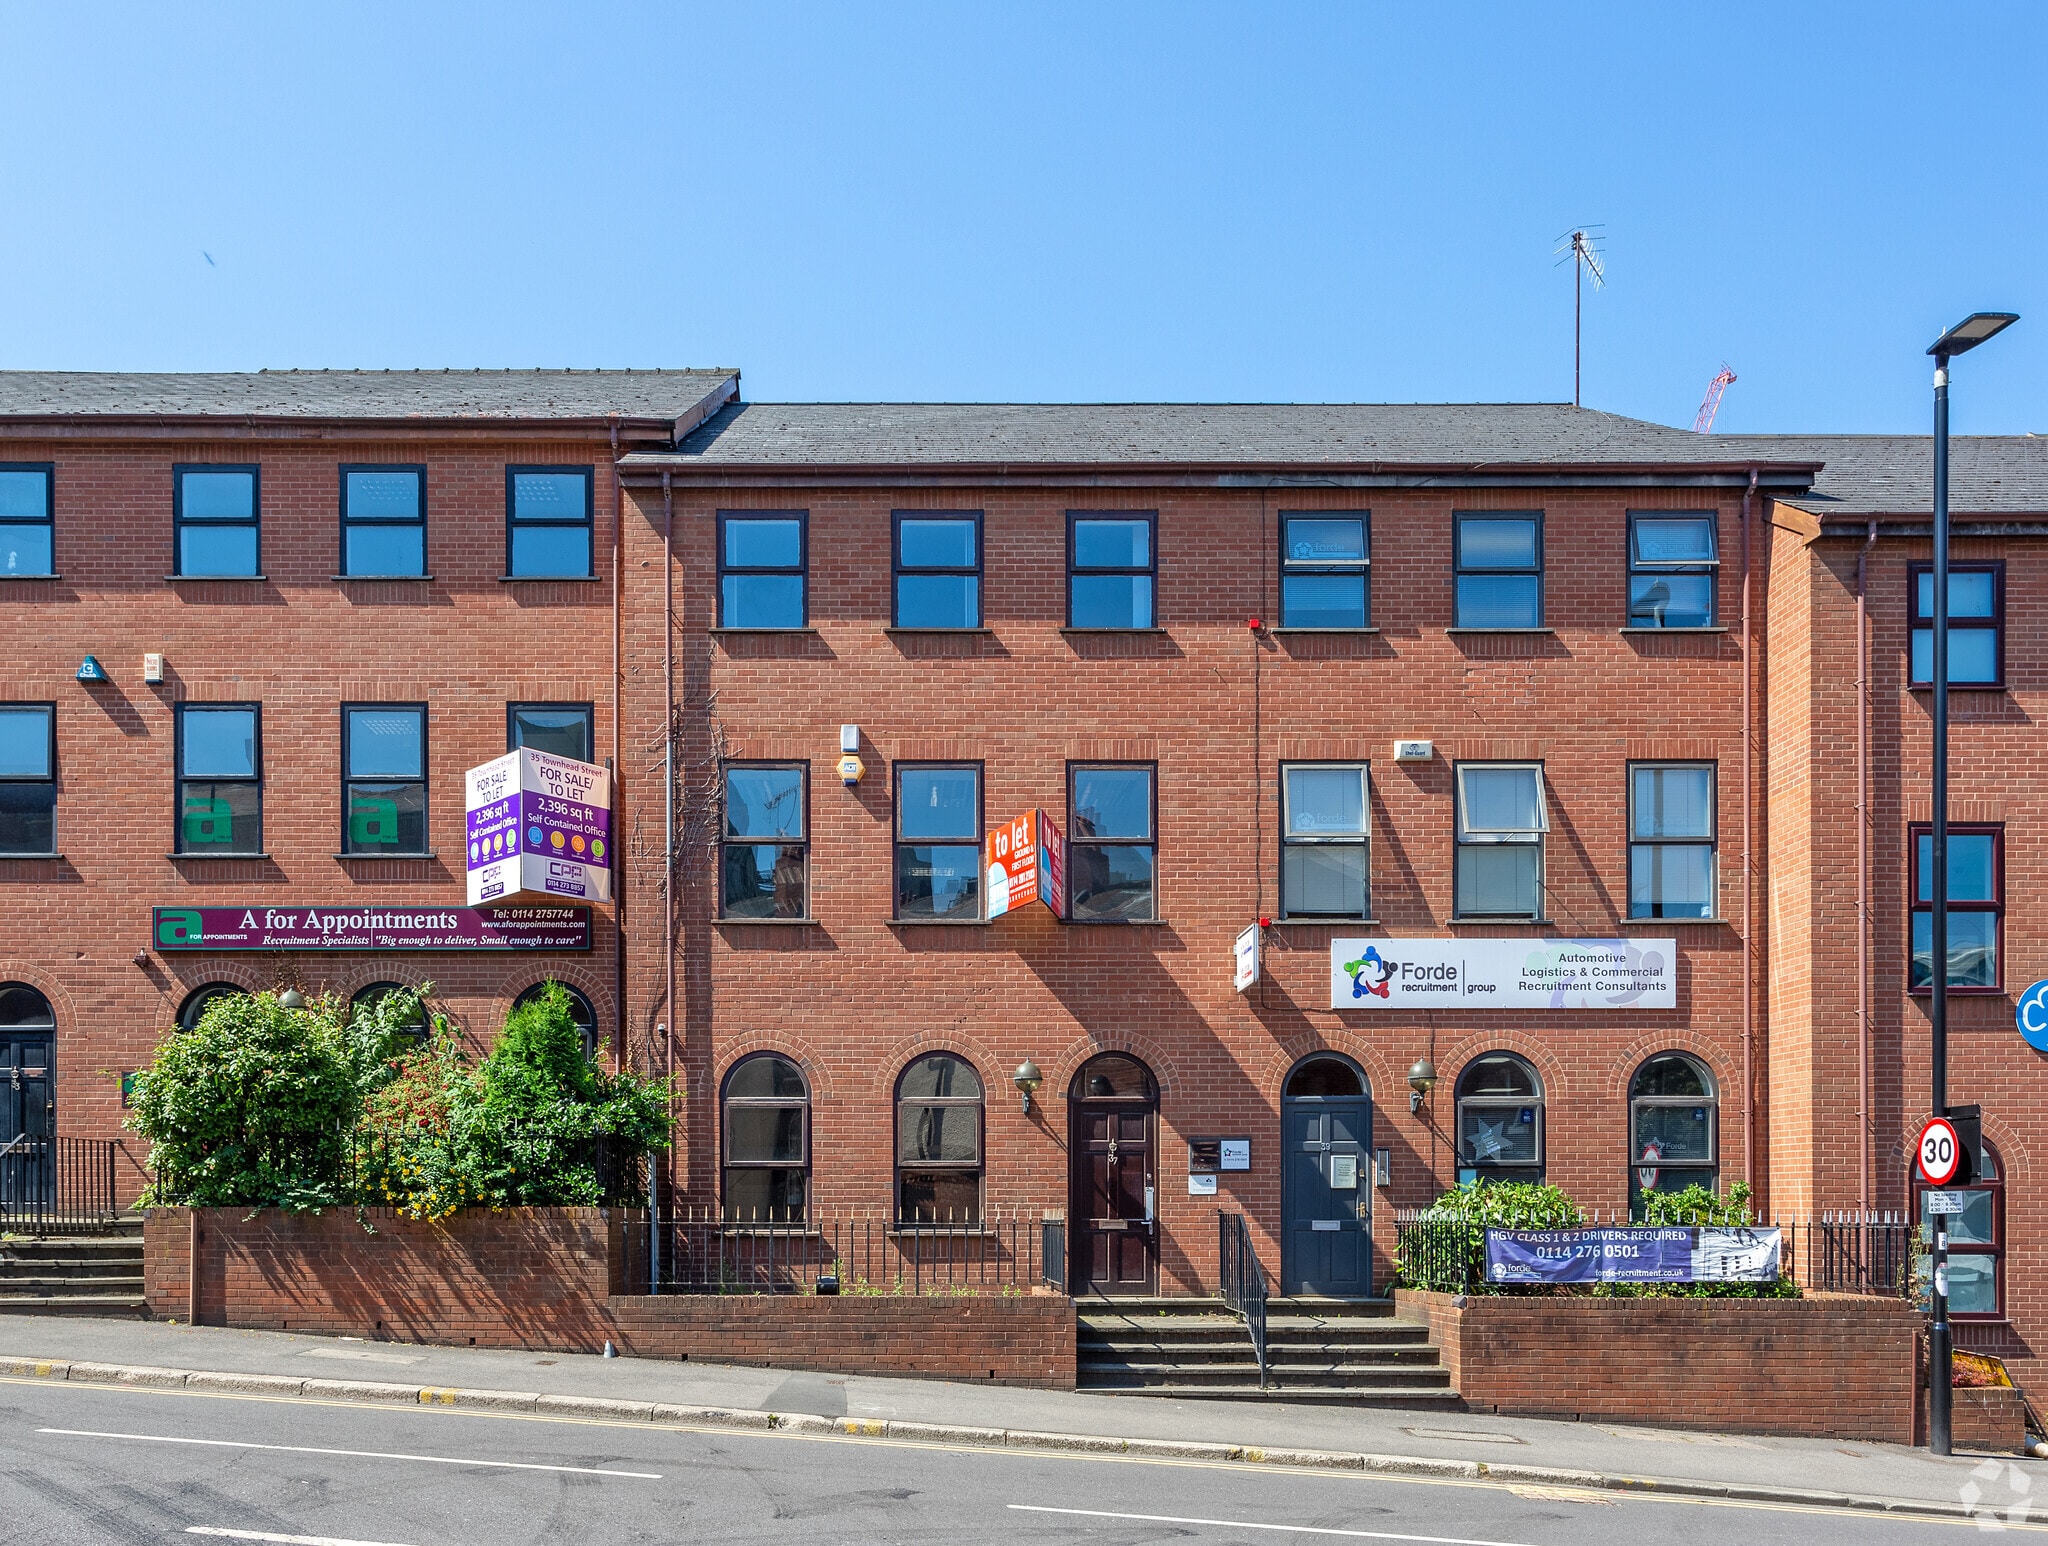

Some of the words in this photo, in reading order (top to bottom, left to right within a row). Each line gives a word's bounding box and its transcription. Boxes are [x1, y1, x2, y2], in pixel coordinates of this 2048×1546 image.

[530, 752, 540, 762] 35
[542, 756, 579, 772] Townhead
[581, 764, 603, 778] Street
[477, 778, 490, 792] FOR
[540, 766, 561, 782] FOR
[565, 772, 594, 790] SALE/
[482, 791, 491, 804] TO
[493, 786, 503, 799] LET
[549, 783, 563, 796] TO
[566, 787, 585, 801] LET
[476, 806, 494, 825] 2,396
[495, 805, 502, 818] sq
[503, 800, 509, 814] ft
[538, 798, 568, 815] 2,396
[570, 807, 582, 821] sq
[584, 808, 593, 821] ft
[470, 827, 480, 840] Self
[480, 820, 502, 837] Contained
[503, 816, 517, 828] Office
[528, 812, 542, 824] Self
[544, 816, 583, 833] Contained
[584, 824, 606, 838] Office
[995, 831, 1008, 858] to
[1012, 817, 1028, 850] let
[1044, 817, 1051, 849] to
[1052, 826, 1060, 859] let
[1012, 860, 1021, 871] FIRST
[1022, 854, 1035, 866] FLOOR
[239, 910, 259, 929] A
[265, 909, 297, 929] for
[303, 909, 457, 934] Appointments
[493, 909, 509, 918] Tel:
[512, 909, 533, 918] 0114
[536, 909, 574, 918] 2757744
[481, 920, 585, 929] www.aforappointments.com
[263, 935, 320, 945] Recruitment
[322, 935, 369, 947] Specialists
[398, 937, 432, 946] enough
[433, 937, 443, 945] to
[445, 936, 477, 946] deliver,
[480, 935, 507, 945] Small
[509, 937, 542, 946] enough
[545, 937, 553, 945] to
[1558, 953, 1626, 963] Automotive
[1402, 963, 1457, 980] Forde
[1522, 967, 1576, 978] Logistics
[1580, 967, 1588, 976] &
[1592, 967, 1663, 976] Commercial
[1402, 983, 1457, 992] recruitment
[1468, 984, 1496, 993] group
[1519, 982, 1591, 990] Recruitment
[1595, 982, 1666, 991] Consultants
[1925, 1138, 1951, 1163] 30
[1109, 1154, 1118, 1165] 37
[1490, 1231, 1515, 1240] HGV
[1517, 1233, 1550, 1242] CLASS
[1554, 1233, 1559, 1242] 1
[1562, 1233, 1570, 1242] &
[1574, 1233, 1579, 1241] 2
[1582, 1231, 1628, 1240] DRIVERS
[1631, 1231, 1686, 1241] REQUIRED
[1537, 1246, 1572, 1259] 0114
[1575, 1245, 1600, 1258] 276
[1604, 1244, 1640, 1258] 0501
[1508, 1264, 1531, 1272] forde
[1595, 1269, 1684, 1277] forde-recruitment.co.uk
